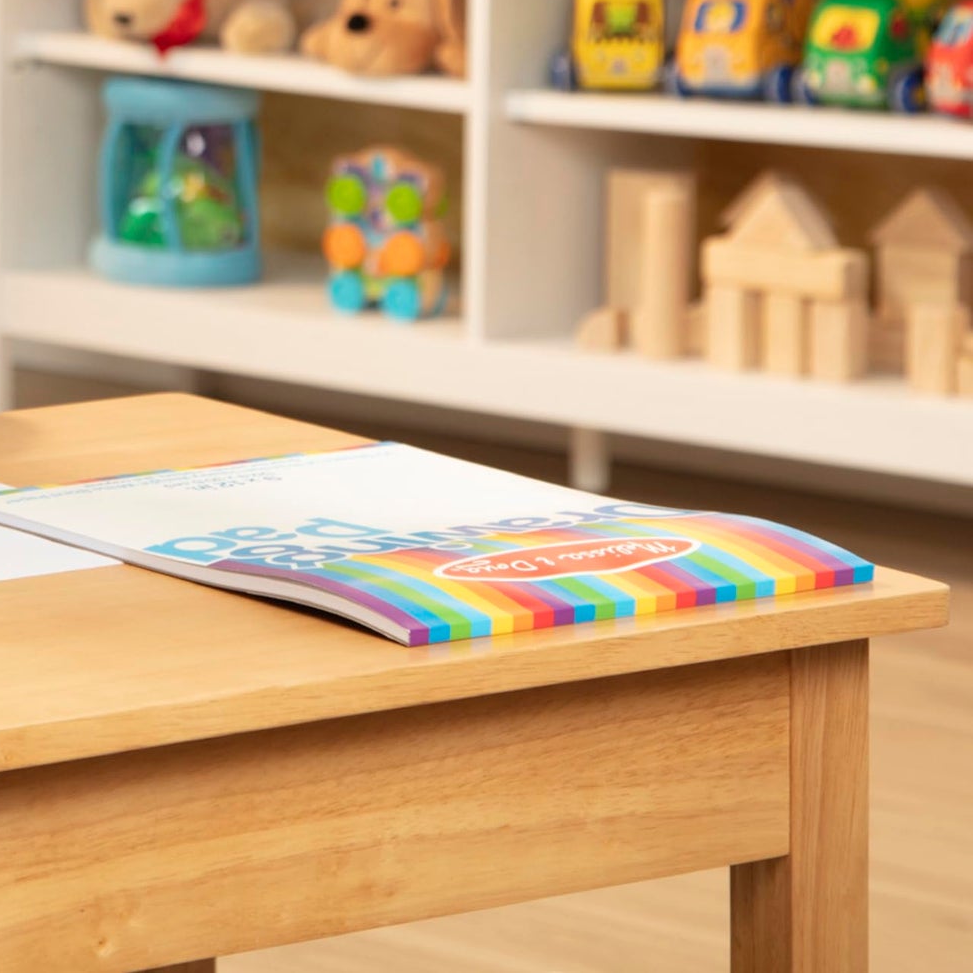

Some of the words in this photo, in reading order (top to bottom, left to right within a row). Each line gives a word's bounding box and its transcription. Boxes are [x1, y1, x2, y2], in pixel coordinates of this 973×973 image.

[141, 517, 394, 563] pad
[229, 504, 701, 568] Drawing
[558, 540, 677, 558] Melissa
